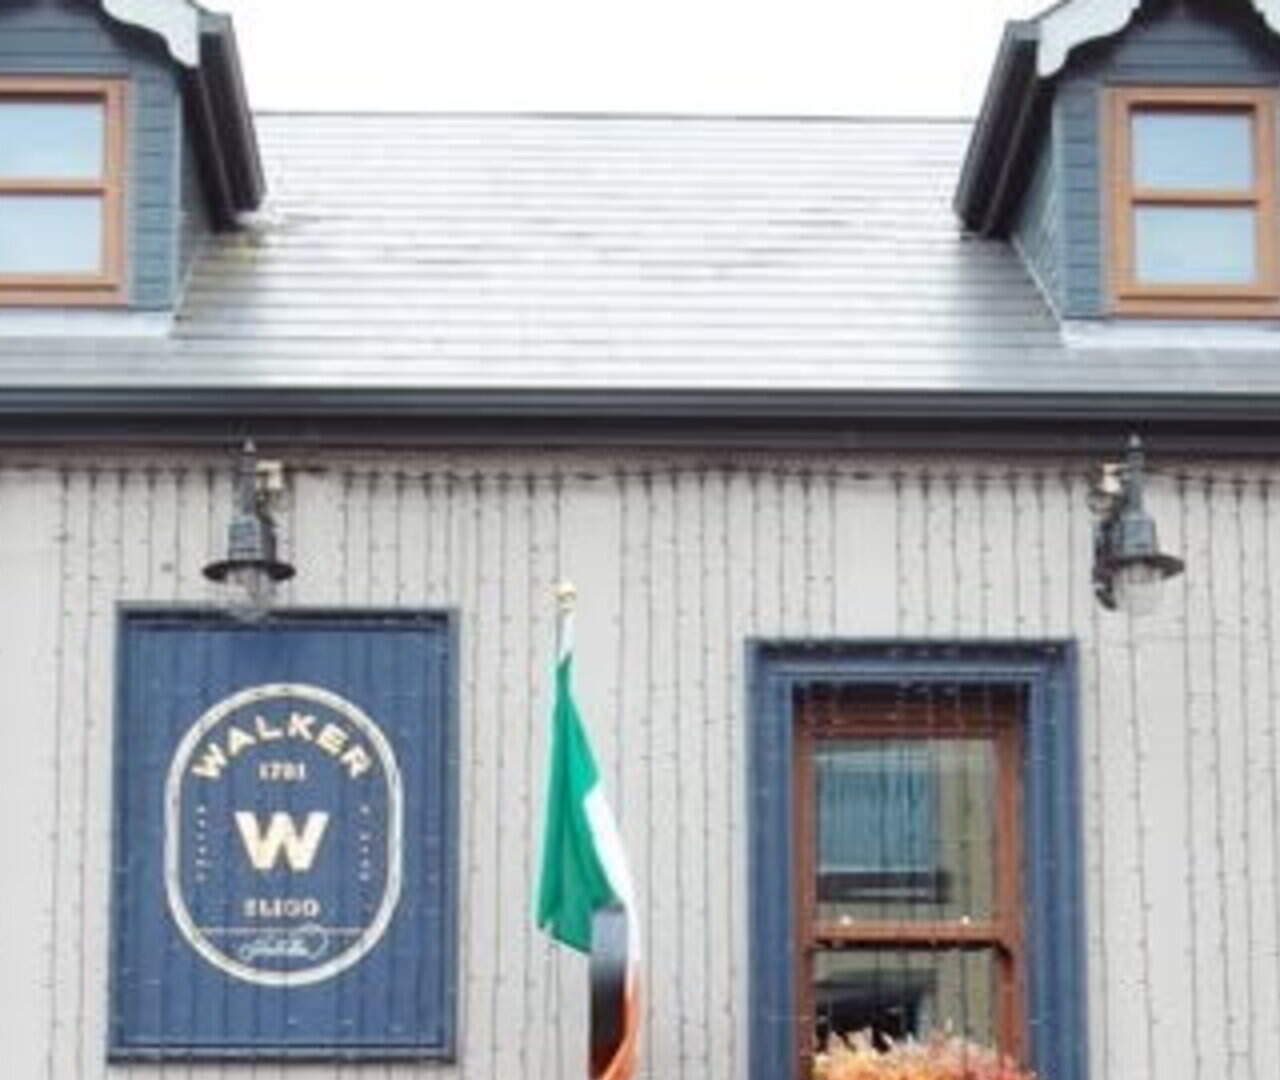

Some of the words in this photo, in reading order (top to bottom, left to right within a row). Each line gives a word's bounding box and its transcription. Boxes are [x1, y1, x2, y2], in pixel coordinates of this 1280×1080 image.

[191, 711, 373, 782] WALKER
[258, 761, 306, 781] 1781
[234, 810, 330, 872] W
